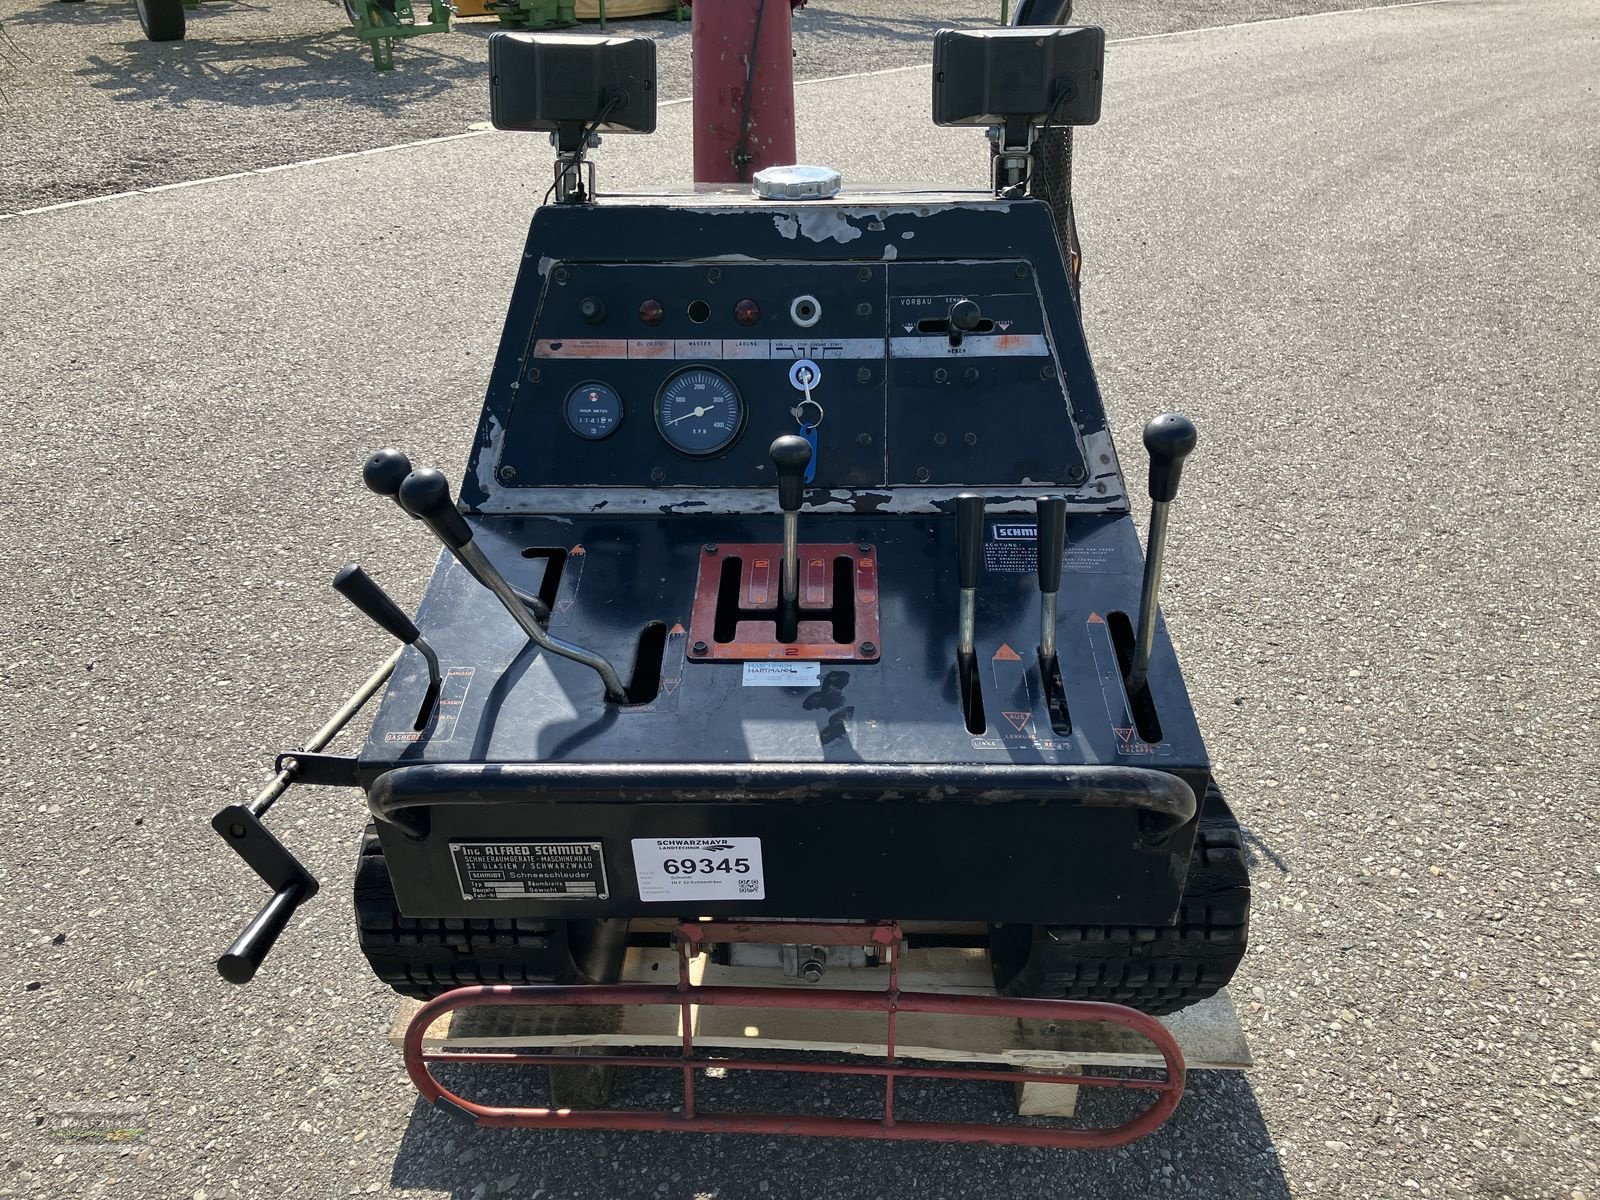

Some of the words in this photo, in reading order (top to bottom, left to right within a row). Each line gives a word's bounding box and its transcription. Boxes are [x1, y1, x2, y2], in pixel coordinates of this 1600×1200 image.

[900, 298, 932, 306] VORBAU
[999, 528, 1038, 536] SCHMI
[754, 560, 769, 568] 2
[810, 560, 824, 568] 4
[785, 647, 799, 656] 2
[485, 846, 530, 855] ALFRED
[535, 845, 590, 855] SCHMIDT
[663, 858, 751, 875] 69345
[509, 871, 590, 879] Schneeschleuder
